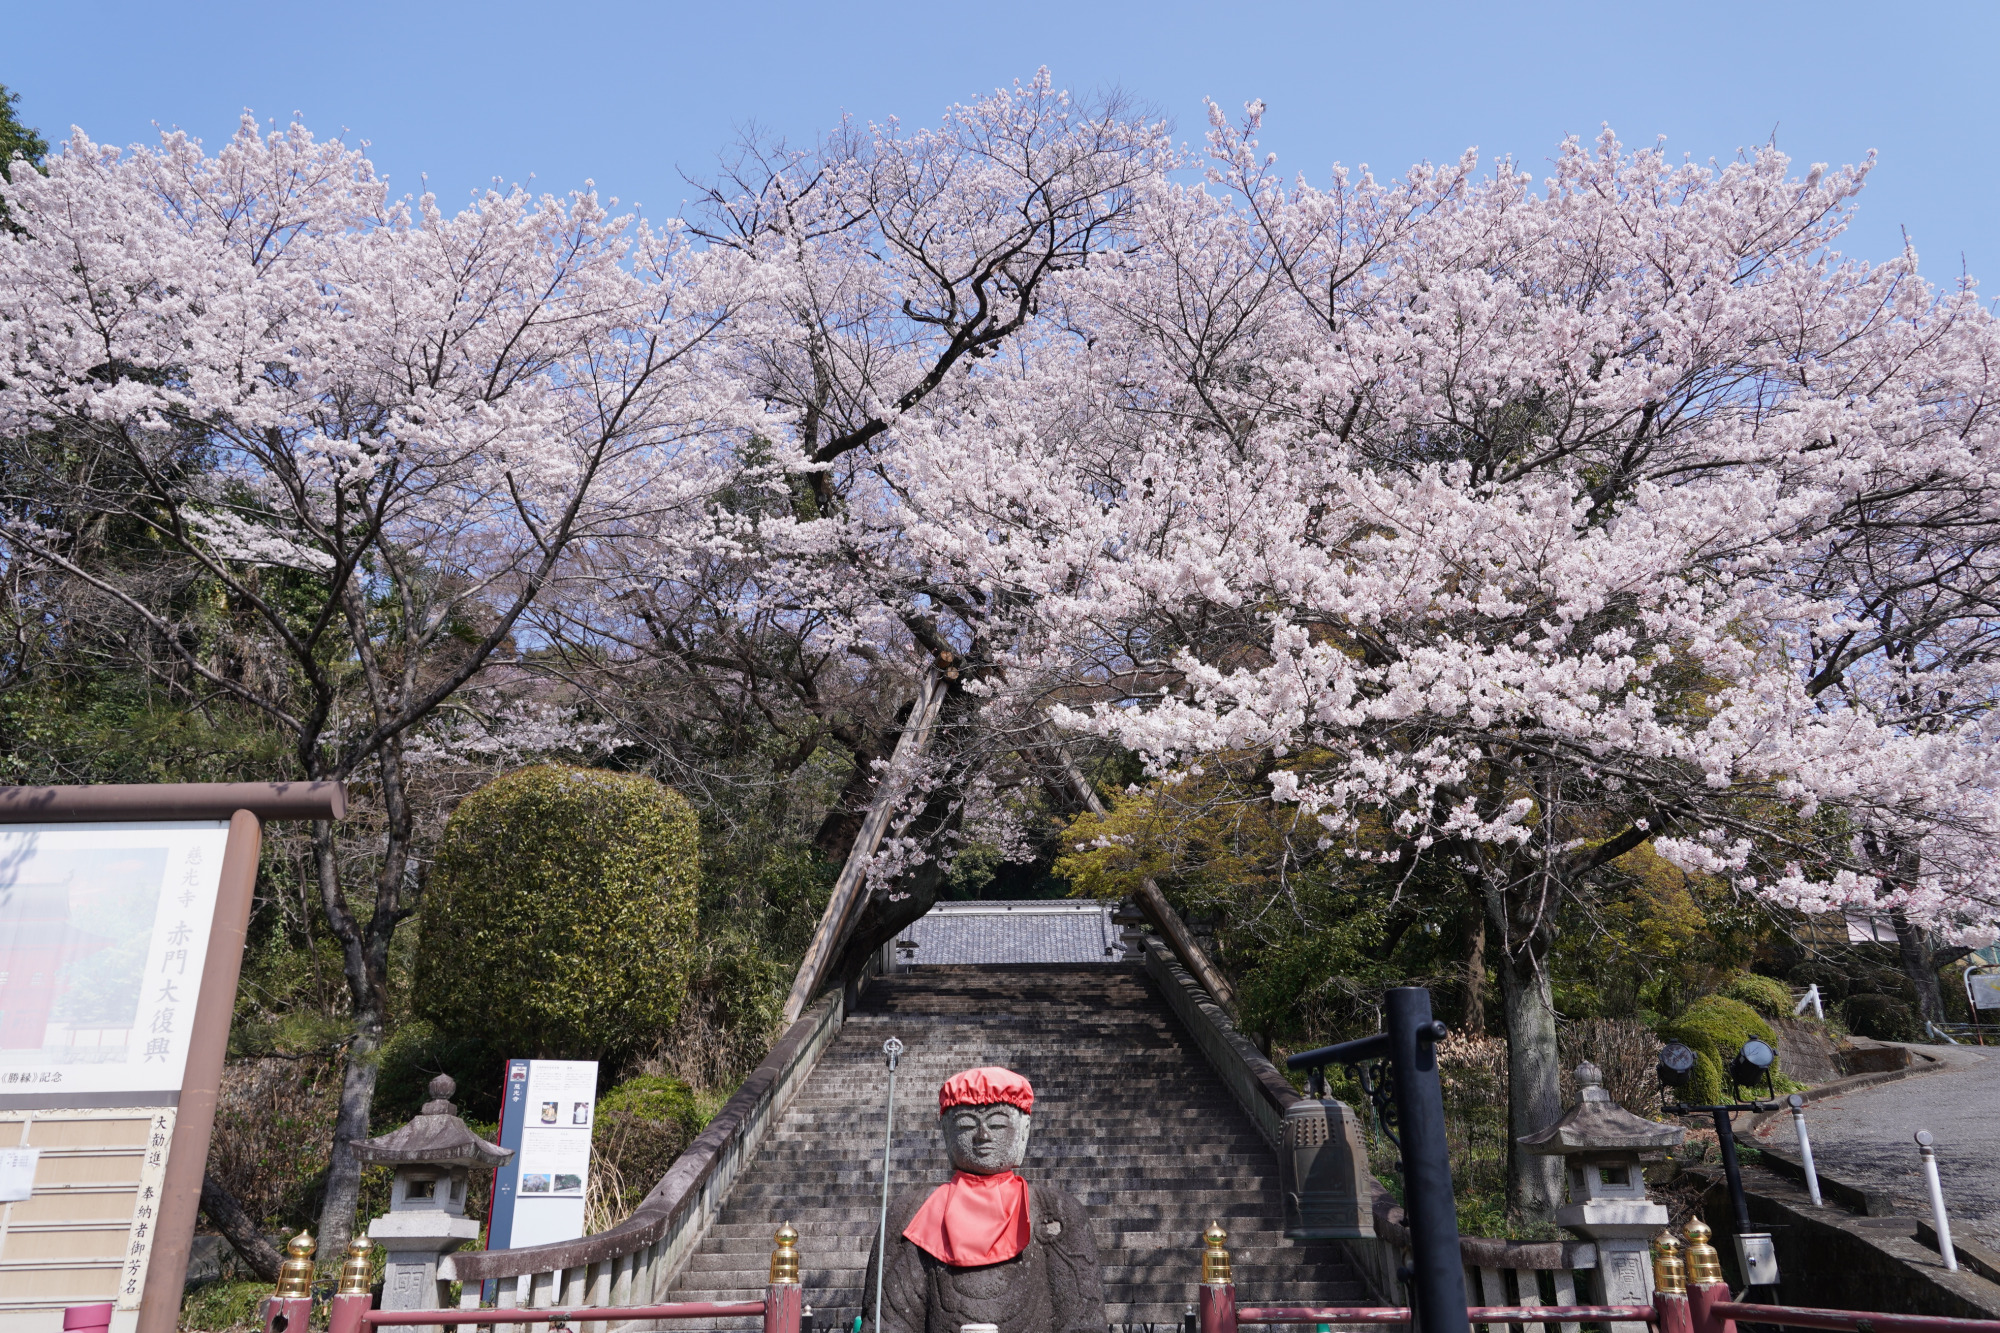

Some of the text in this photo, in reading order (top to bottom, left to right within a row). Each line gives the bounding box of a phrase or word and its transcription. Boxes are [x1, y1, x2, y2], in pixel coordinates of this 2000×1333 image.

[143, 920, 193, 1064] 赤門大復興
[124, 1116, 166, 1294] 大勧進 奉納者御芳名
